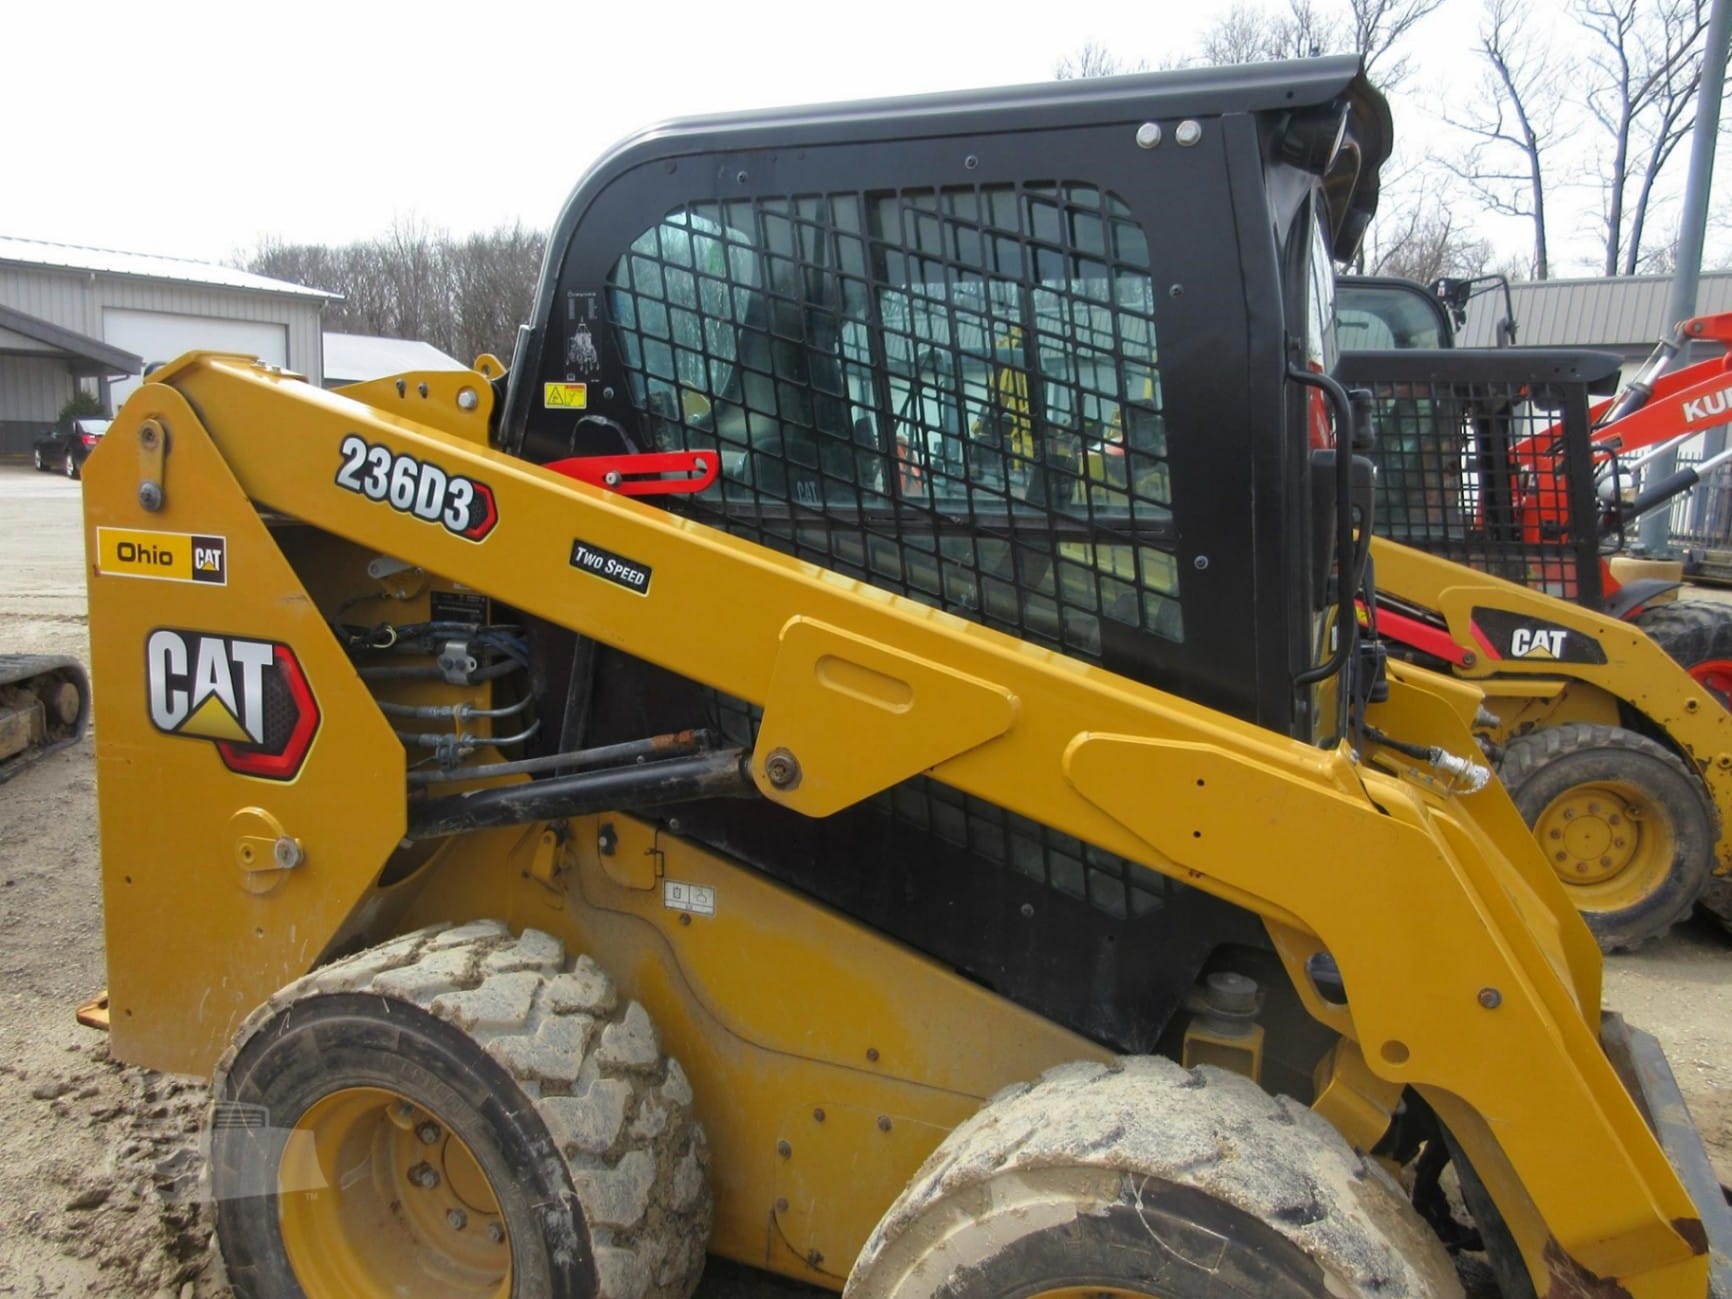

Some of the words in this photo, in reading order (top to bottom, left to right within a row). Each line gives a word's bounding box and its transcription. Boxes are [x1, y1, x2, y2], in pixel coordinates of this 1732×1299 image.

[337, 437, 474, 531] 236D3
[117, 542, 173, 566] Ohio
[195, 548, 221, 572] CAT
[1511, 628, 1567, 659] CAT
[149, 630, 273, 744] CAT
